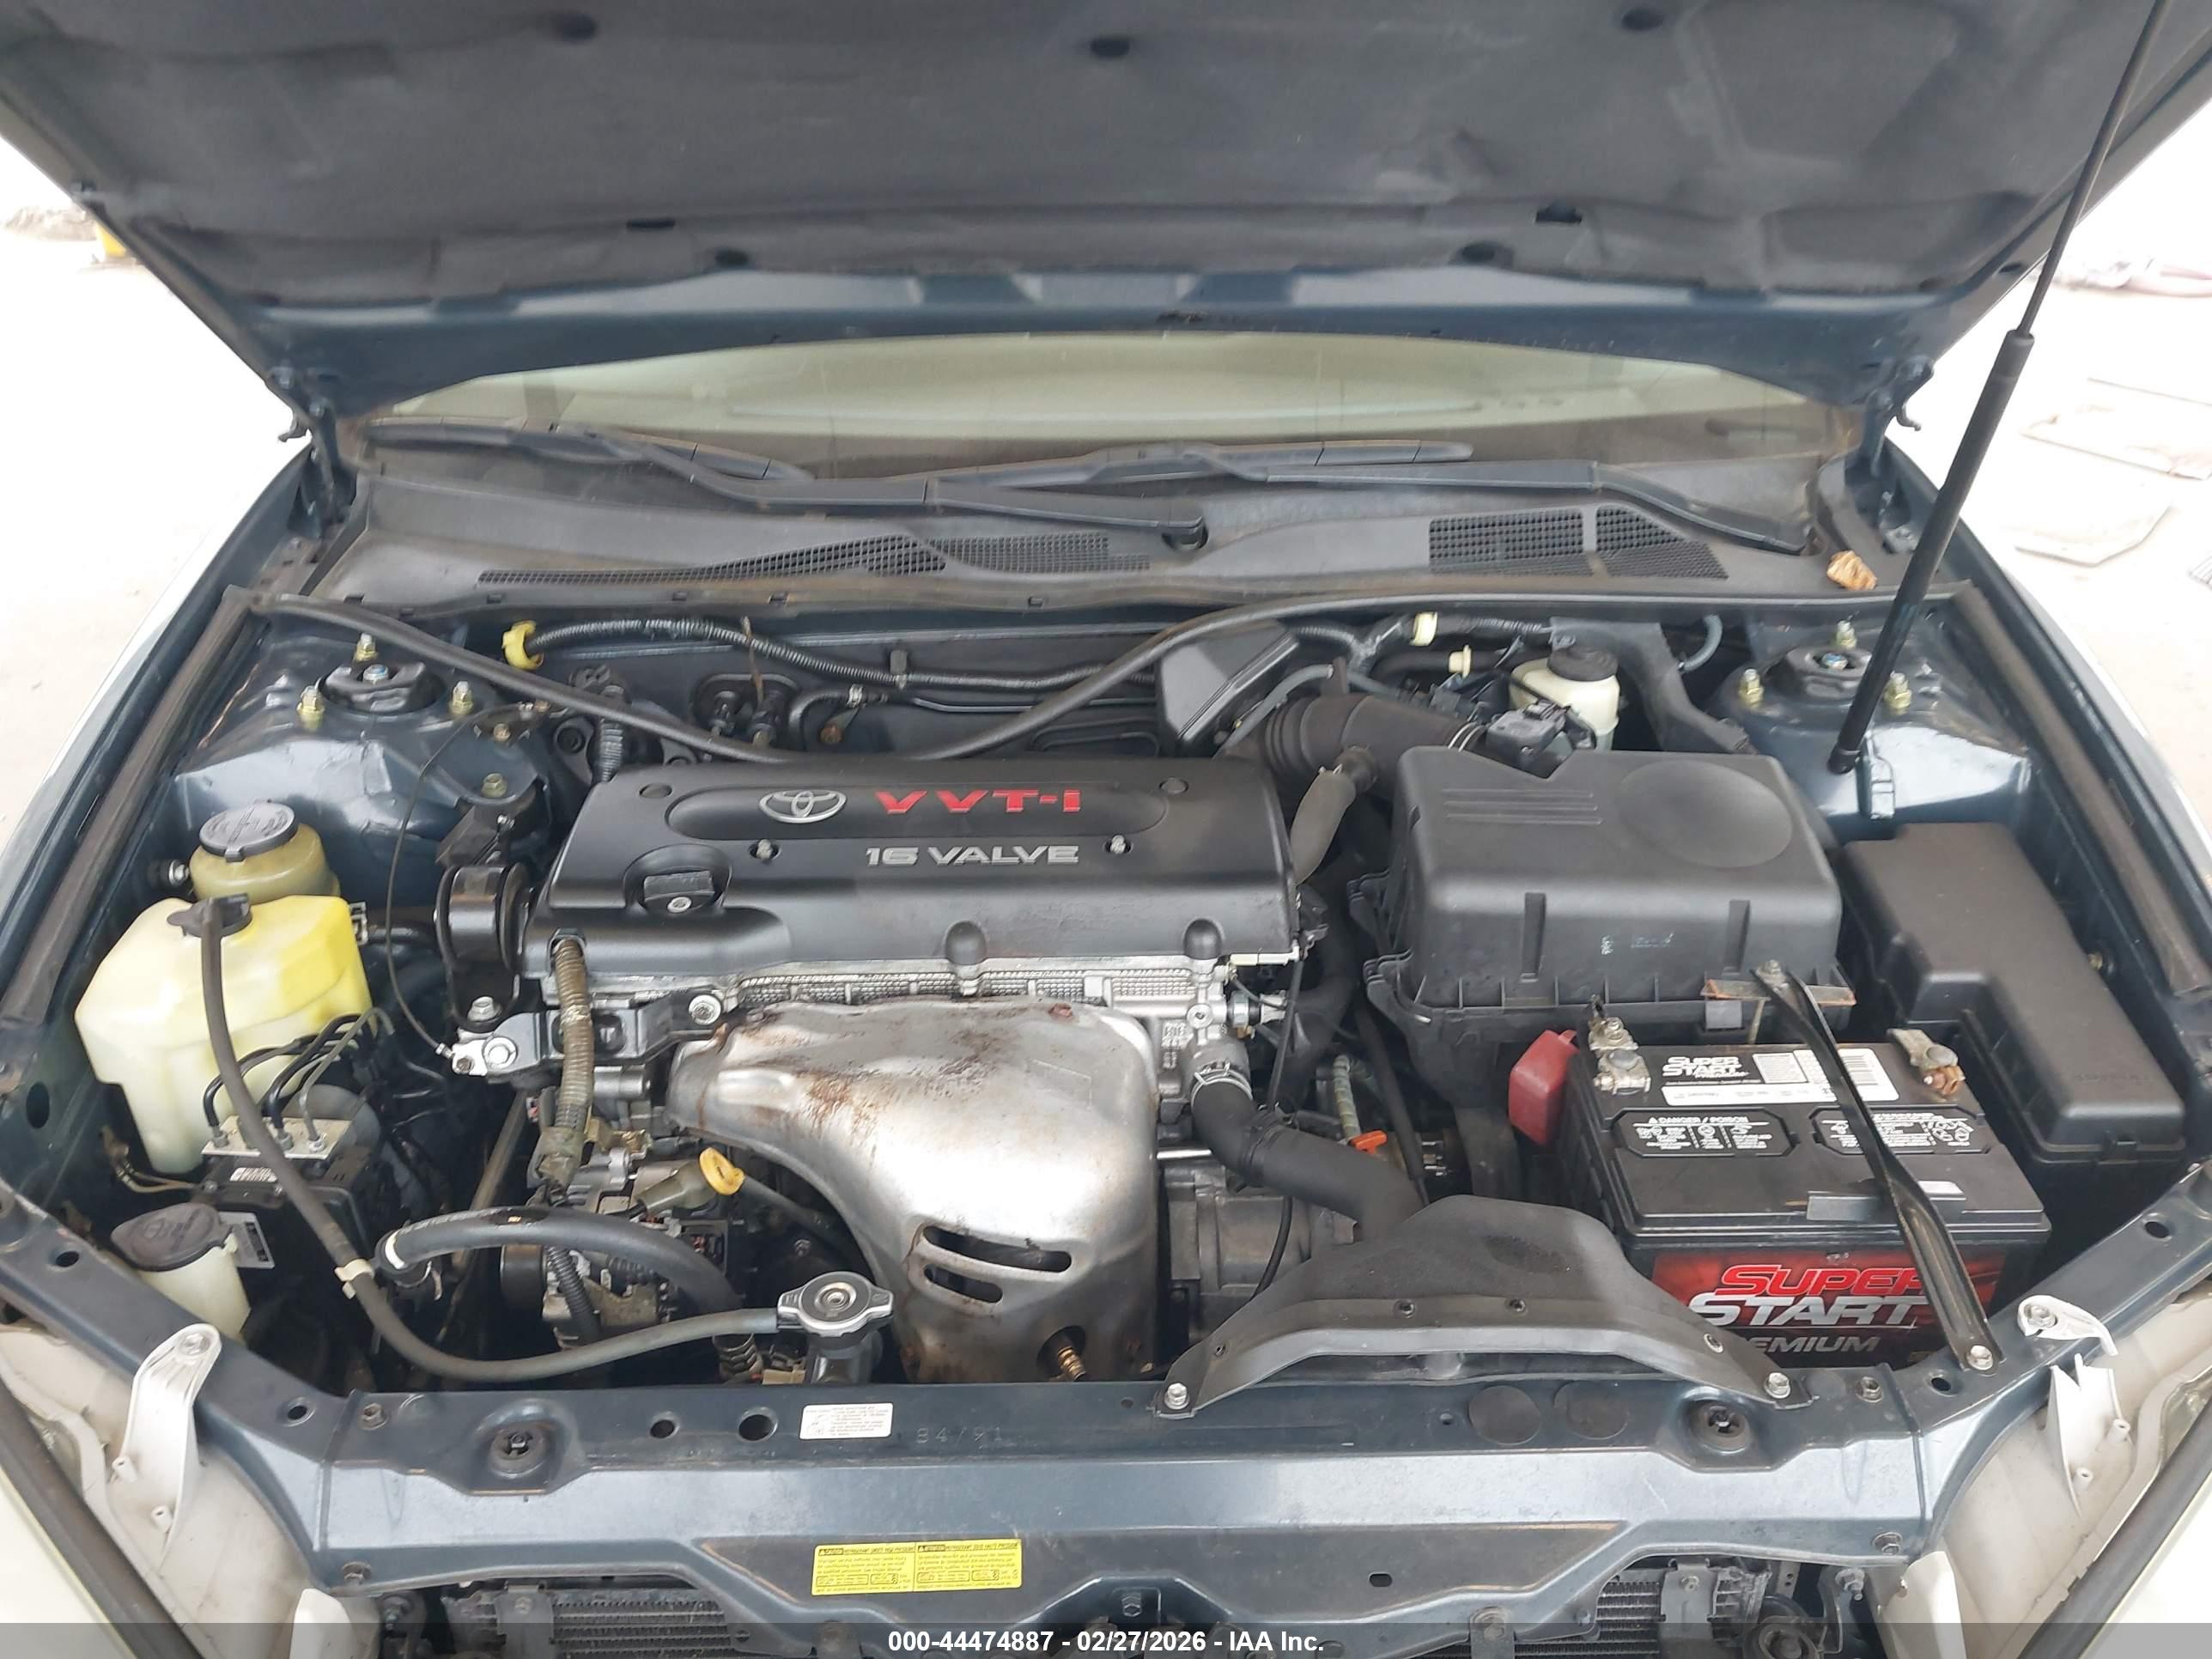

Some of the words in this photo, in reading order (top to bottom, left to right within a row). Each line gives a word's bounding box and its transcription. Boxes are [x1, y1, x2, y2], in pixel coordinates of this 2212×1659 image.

[866, 846, 919, 866] 16
[927, 845, 1079, 866] VALVE
[1668, 1056, 1741, 1066] SUPER
[1662, 1064, 1742, 1077] START
[1688, 1291, 1929, 1327] START
[1750, 1336, 1881, 1352] EMIUM
